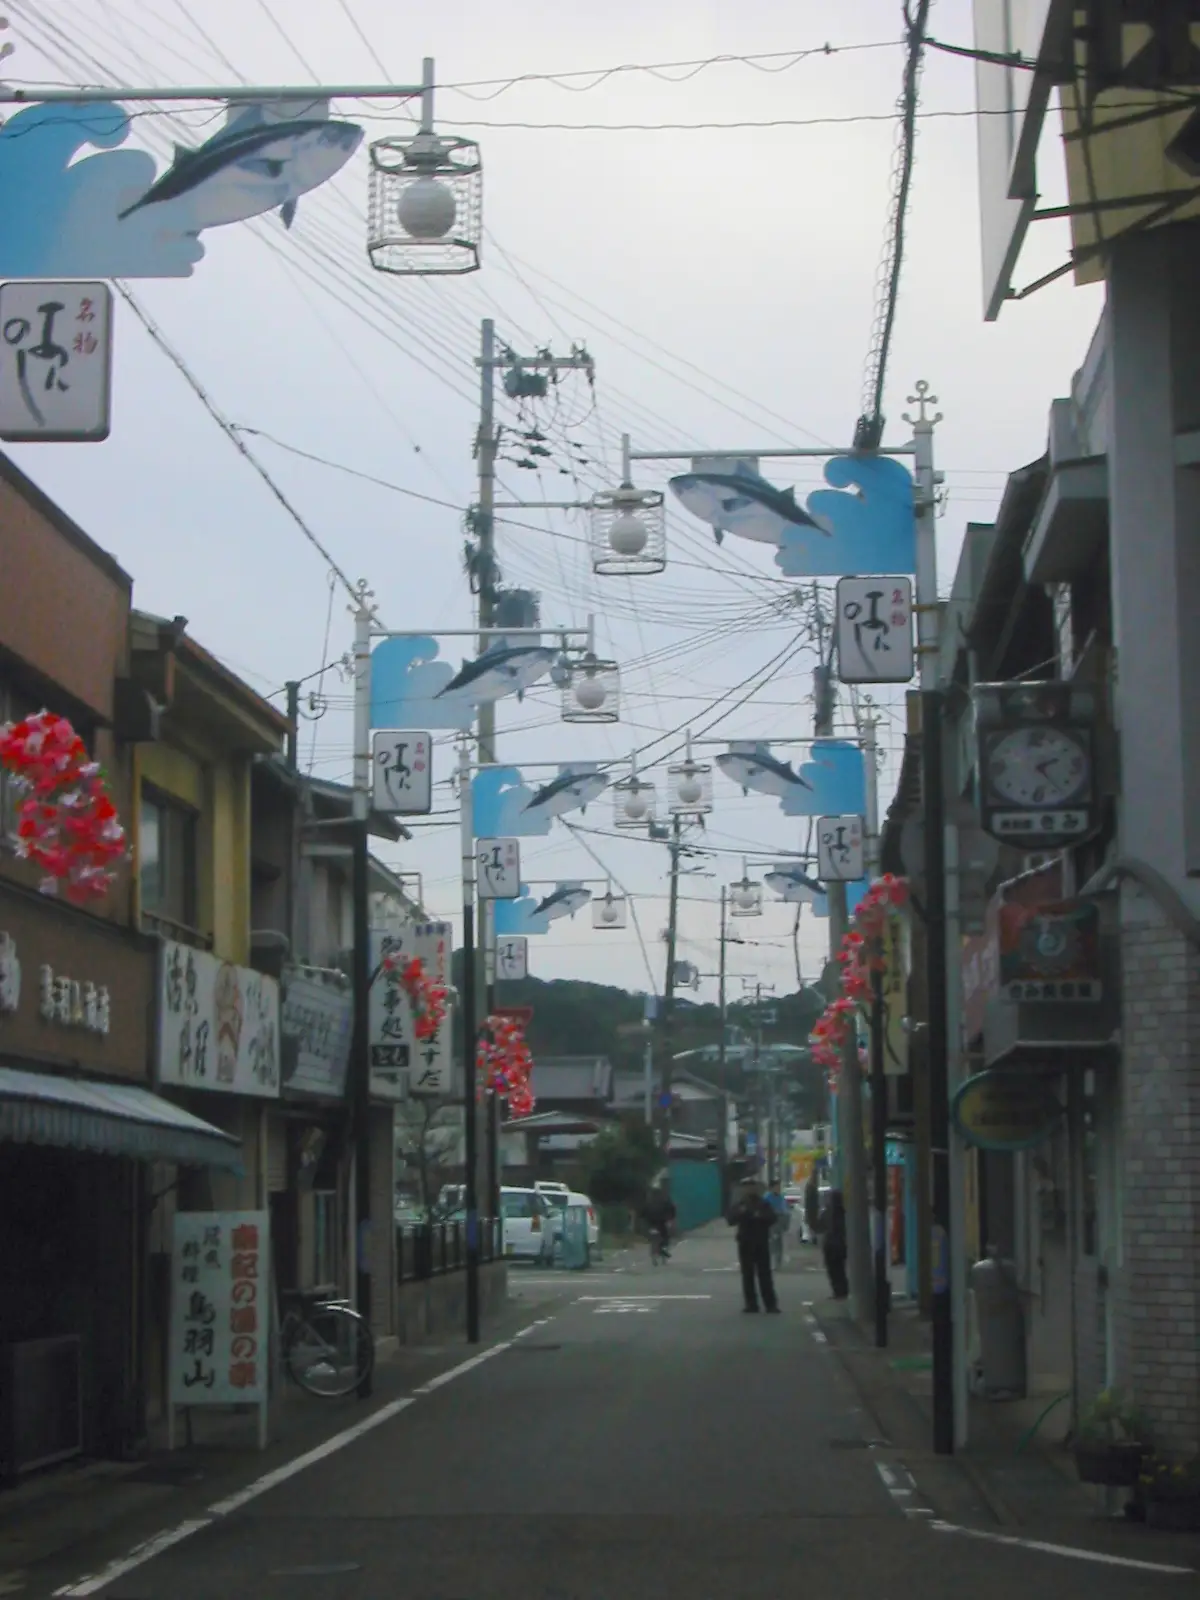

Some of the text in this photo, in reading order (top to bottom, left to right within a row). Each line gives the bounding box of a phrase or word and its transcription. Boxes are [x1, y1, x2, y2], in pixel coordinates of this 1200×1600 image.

[73, 297, 98, 355] 名物
[380, 934, 404, 1041] 御事処
